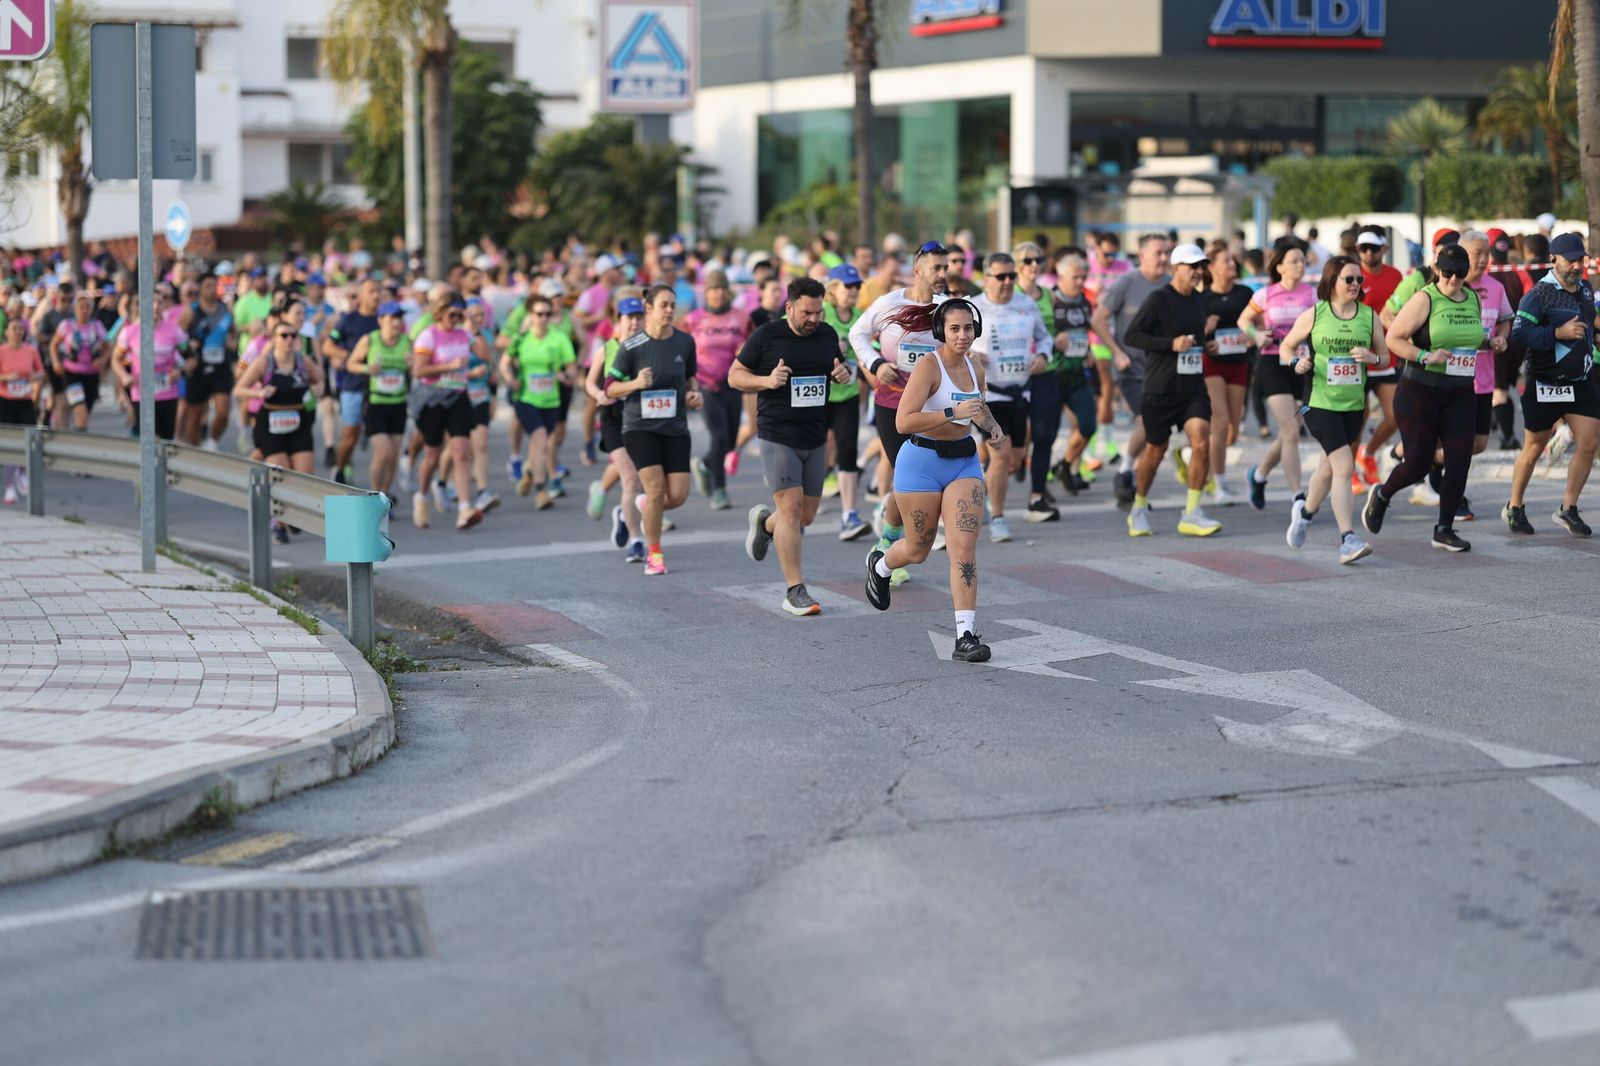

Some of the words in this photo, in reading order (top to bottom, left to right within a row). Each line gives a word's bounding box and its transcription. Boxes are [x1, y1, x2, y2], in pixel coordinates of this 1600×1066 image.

[1210, 0, 1386, 36] ALDI
[1448, 356, 1475, 368] 2162
[1000, 363, 1026, 373] 1722
[1333, 365, 1358, 376] 583
[794, 385, 825, 397] 1293
[1539, 387, 1572, 396] 1784
[647, 398, 671, 409] 434
